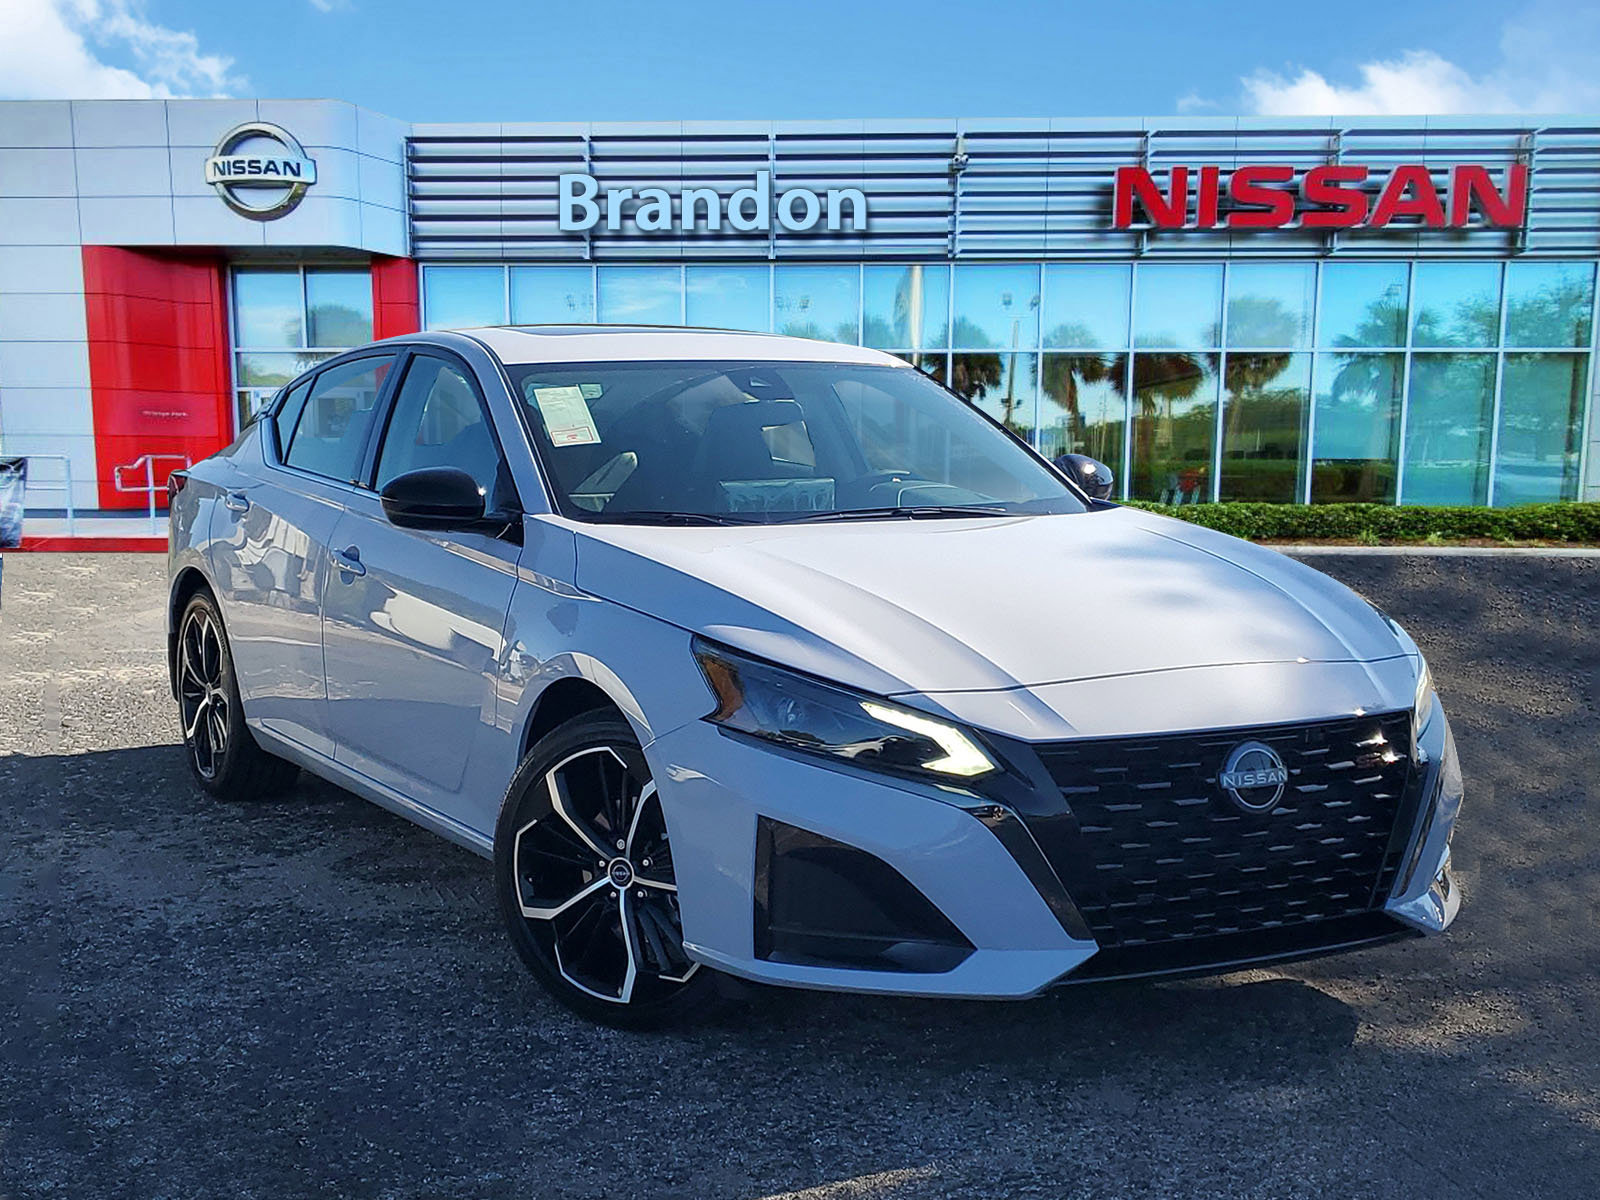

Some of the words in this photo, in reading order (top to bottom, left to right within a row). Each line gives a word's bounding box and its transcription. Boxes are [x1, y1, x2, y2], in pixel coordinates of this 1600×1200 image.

[213, 159, 302, 177] NISSAN
[558, 170, 868, 232] Brandon
[1111, 164, 1529, 229] NISSAN
[1222, 770, 1287, 788] NISSAN
